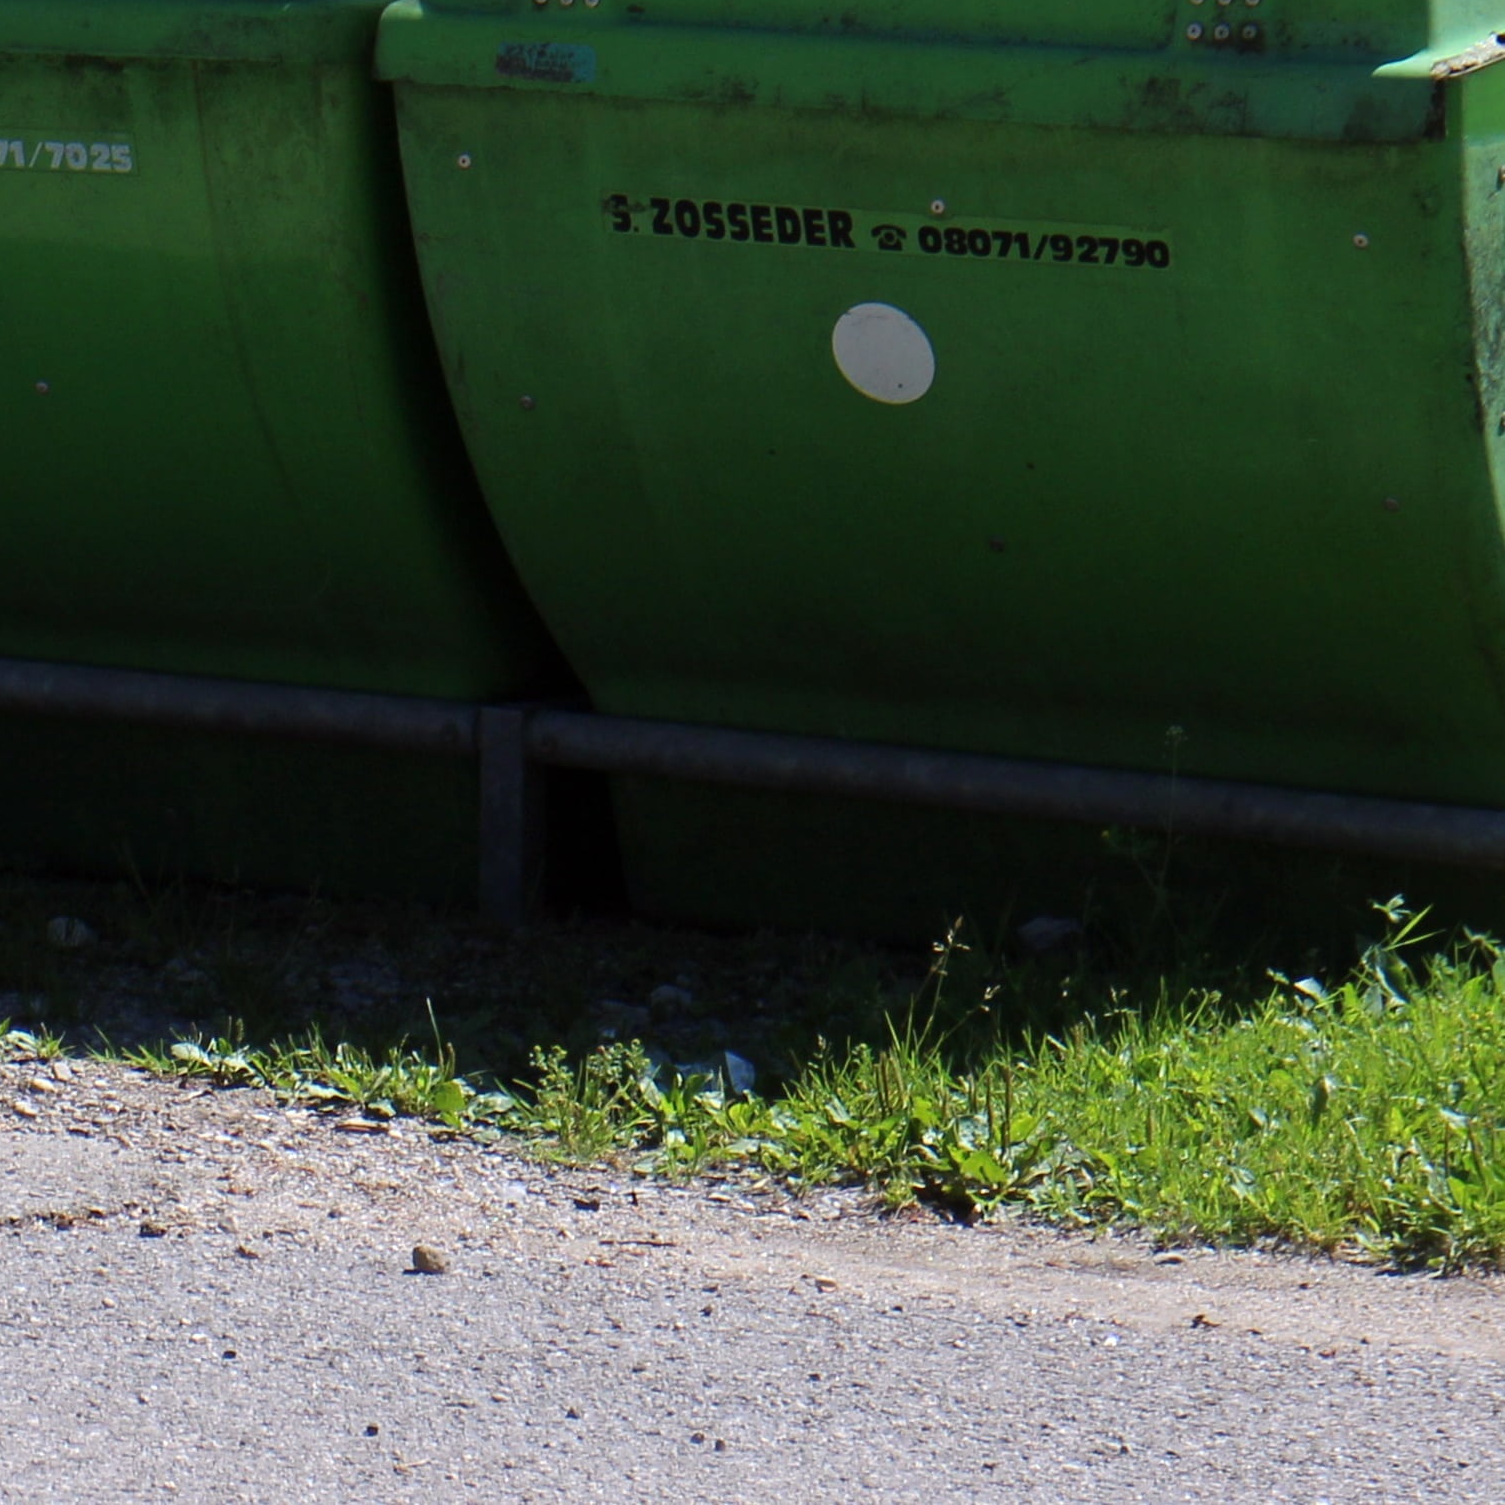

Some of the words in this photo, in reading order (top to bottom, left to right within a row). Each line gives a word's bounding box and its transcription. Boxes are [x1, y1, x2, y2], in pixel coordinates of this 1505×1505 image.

[611, 194, 639, 232] S.
[650, 197, 856, 249] ZOSSEDER
[918, 225, 1170, 268] 08071/92790
